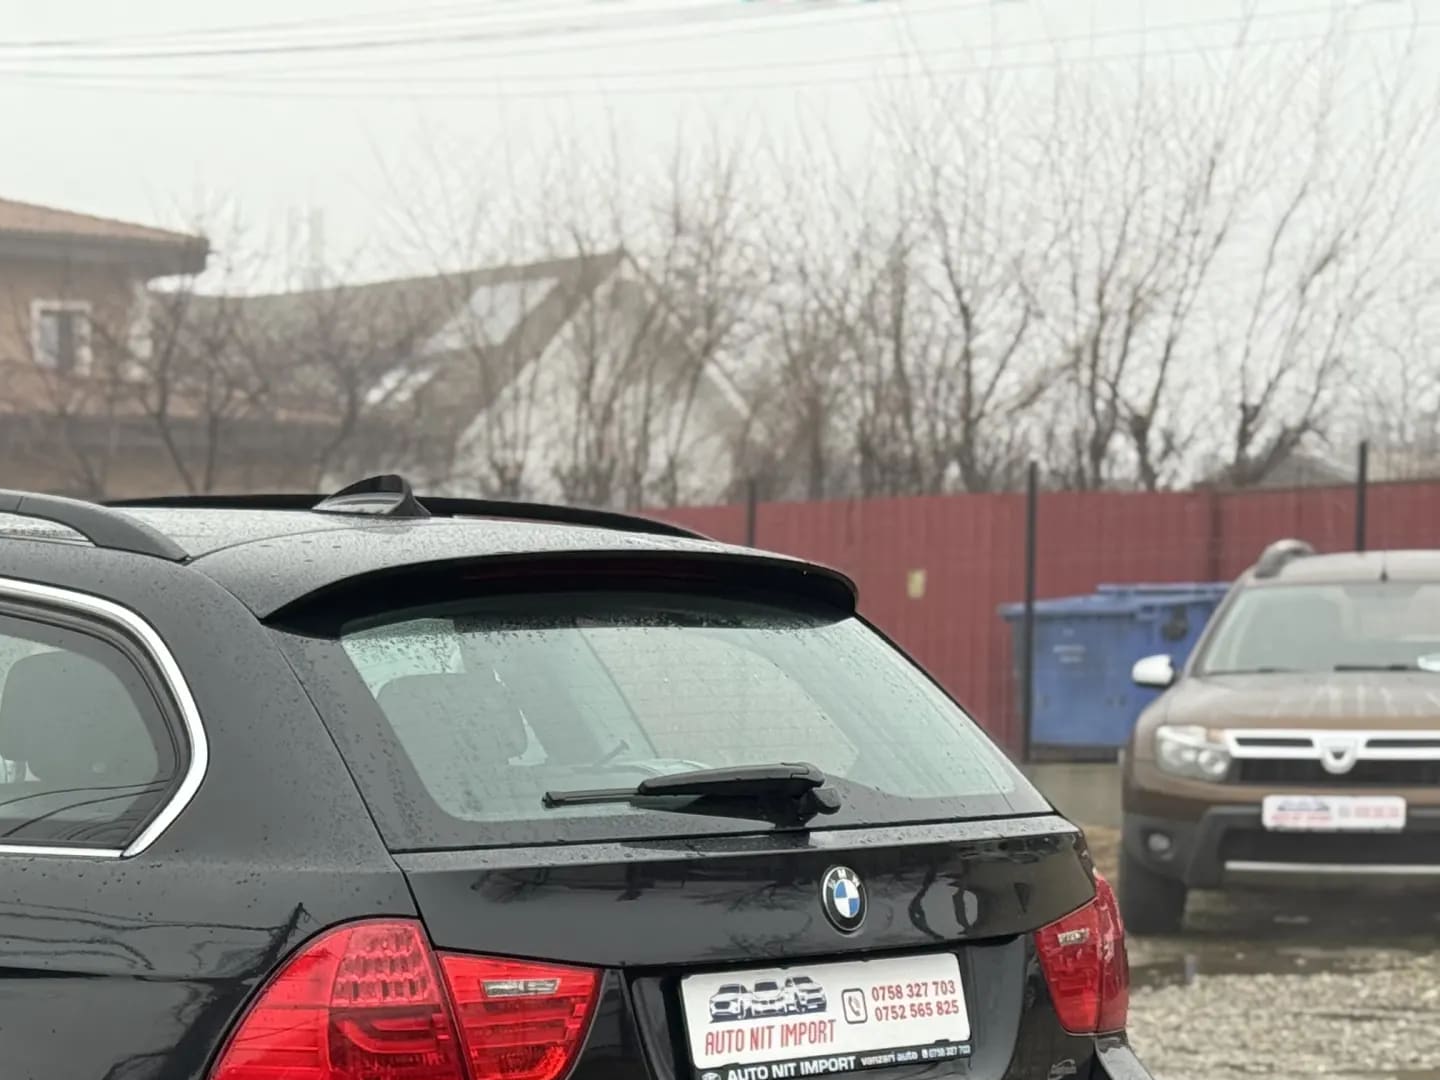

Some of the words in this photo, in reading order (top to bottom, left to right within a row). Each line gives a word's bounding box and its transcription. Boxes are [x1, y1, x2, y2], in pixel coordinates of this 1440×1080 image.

[871, 984, 903, 1001] 0758
[906, 982, 929, 998] 327
[932, 980, 956, 996] 703
[875, 1004, 907, 1022] 0752
[909, 1002, 934, 1018] 565
[936, 999, 960, 1016] 825
[705, 1029, 745, 1056] AUTO
[750, 1025, 774, 1051] NIT
[780, 1019, 837, 1047] IMPORT
[772, 1062, 797, 1079] NIT
[800, 1056, 857, 1076] IMPORT
